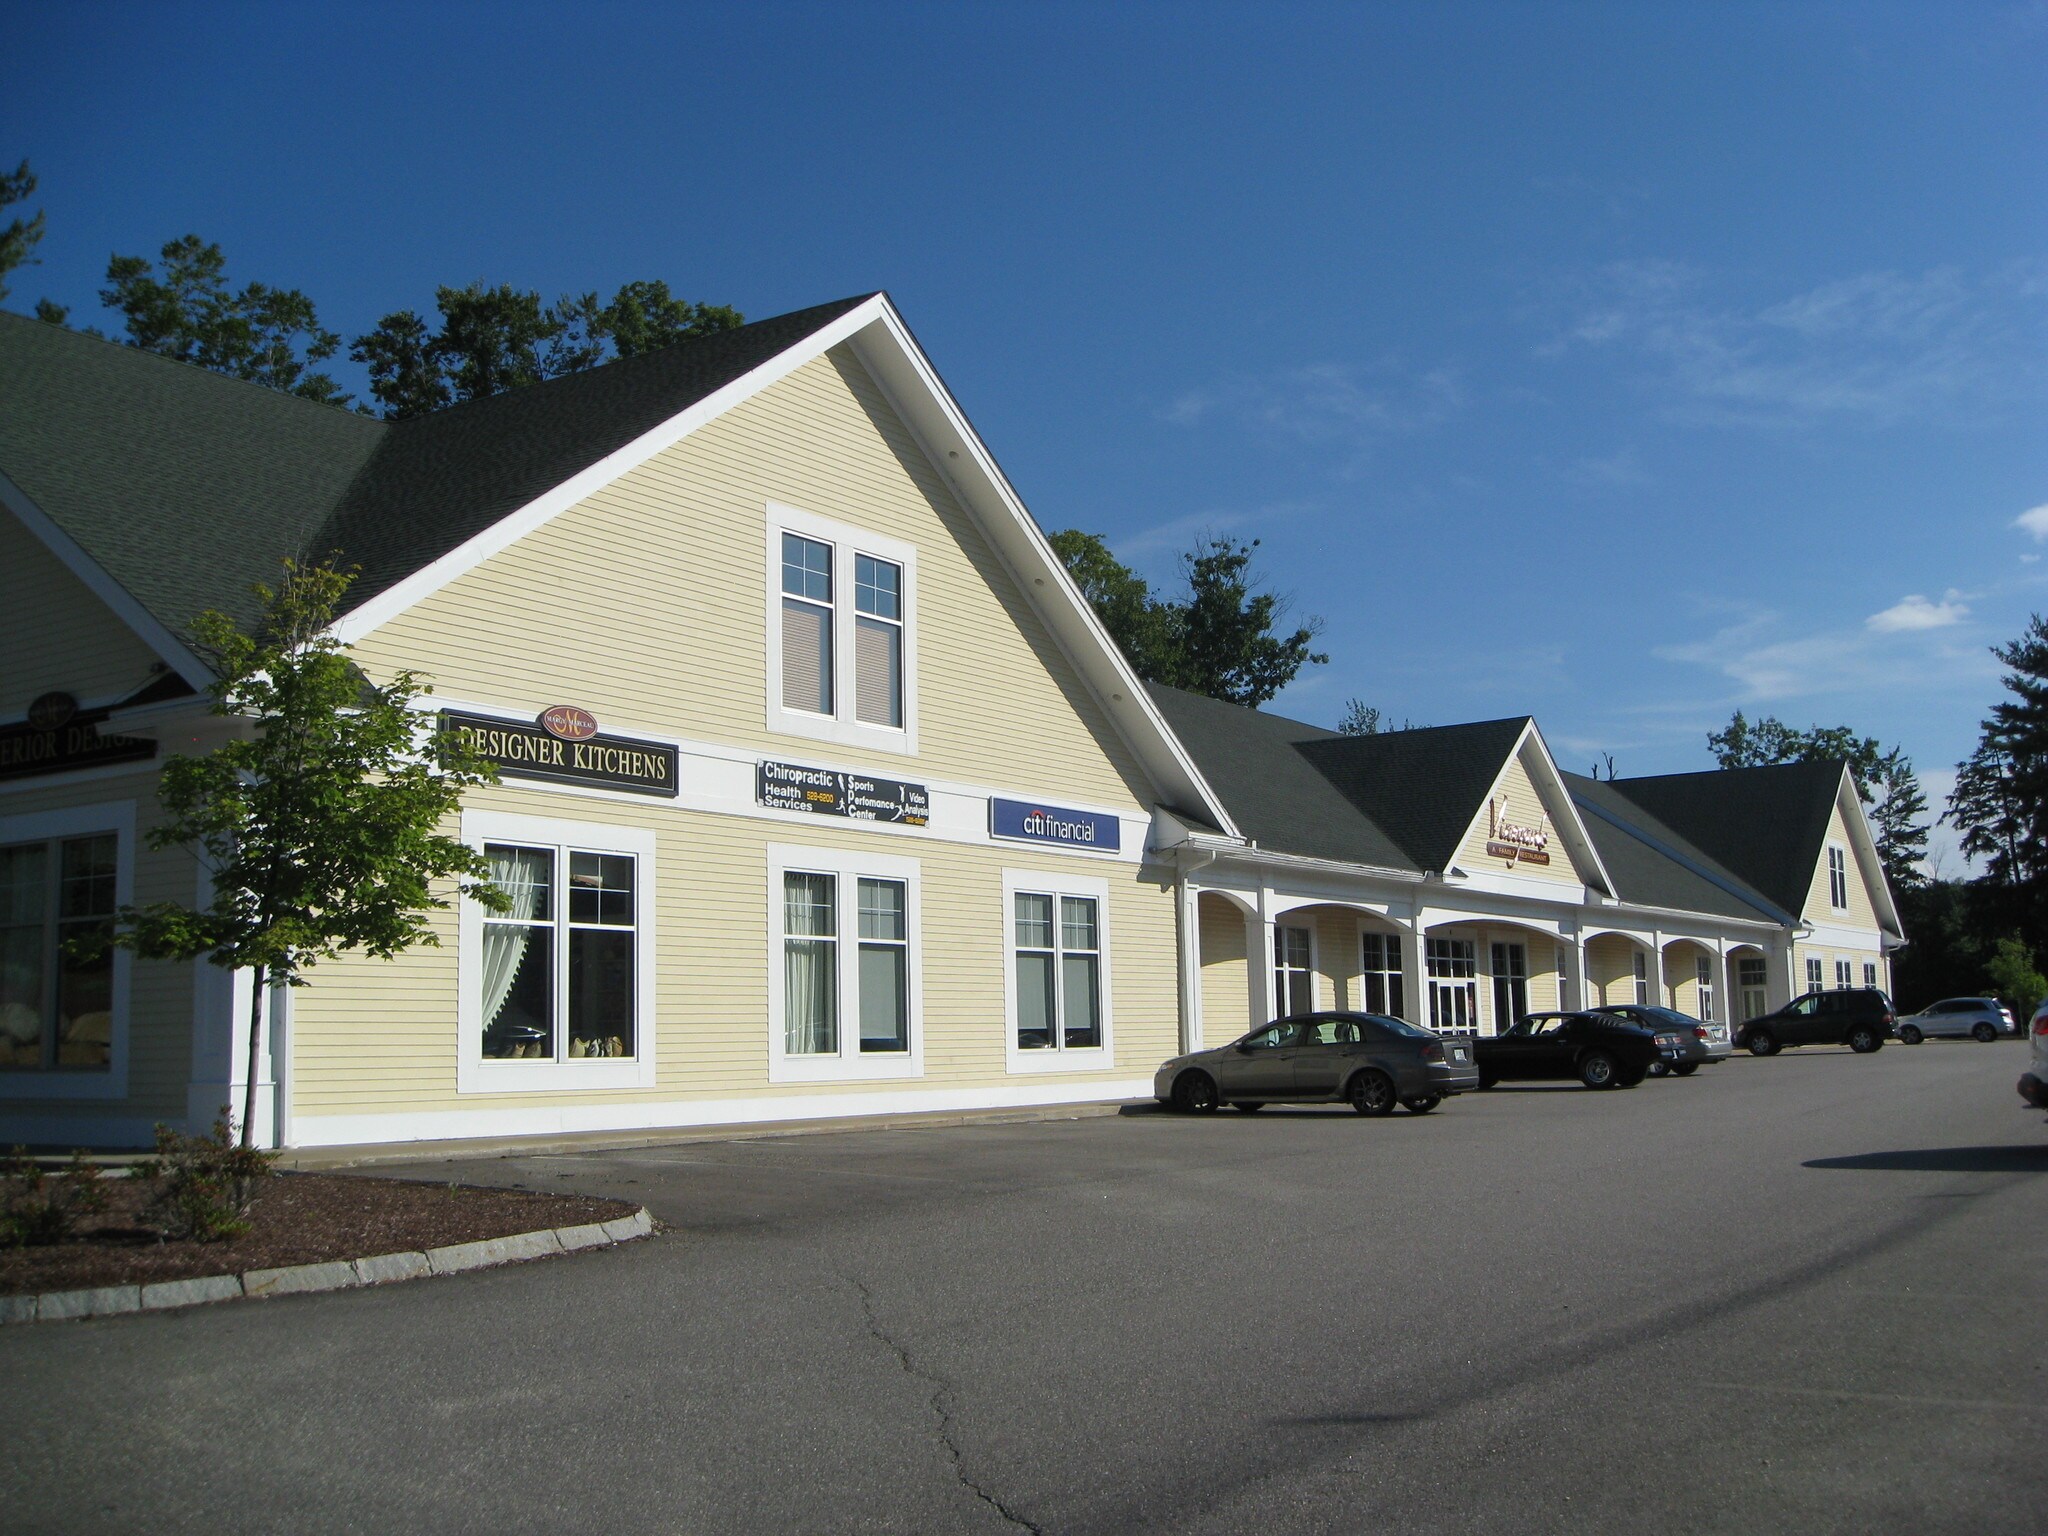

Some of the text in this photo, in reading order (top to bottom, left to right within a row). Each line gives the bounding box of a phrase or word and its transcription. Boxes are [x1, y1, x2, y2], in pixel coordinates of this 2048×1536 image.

[458, 725, 666, 780] DESIGNER KITCHENS
[765, 762, 833, 788] Chiropractic
[765, 783, 801, 799] Health
[847, 775, 875, 792] Sports
[765, 795, 813, 812] Services
[908, 791, 926, 804] Video
[847, 804, 877, 820] Center
[904, 803, 928, 818] Analysis
